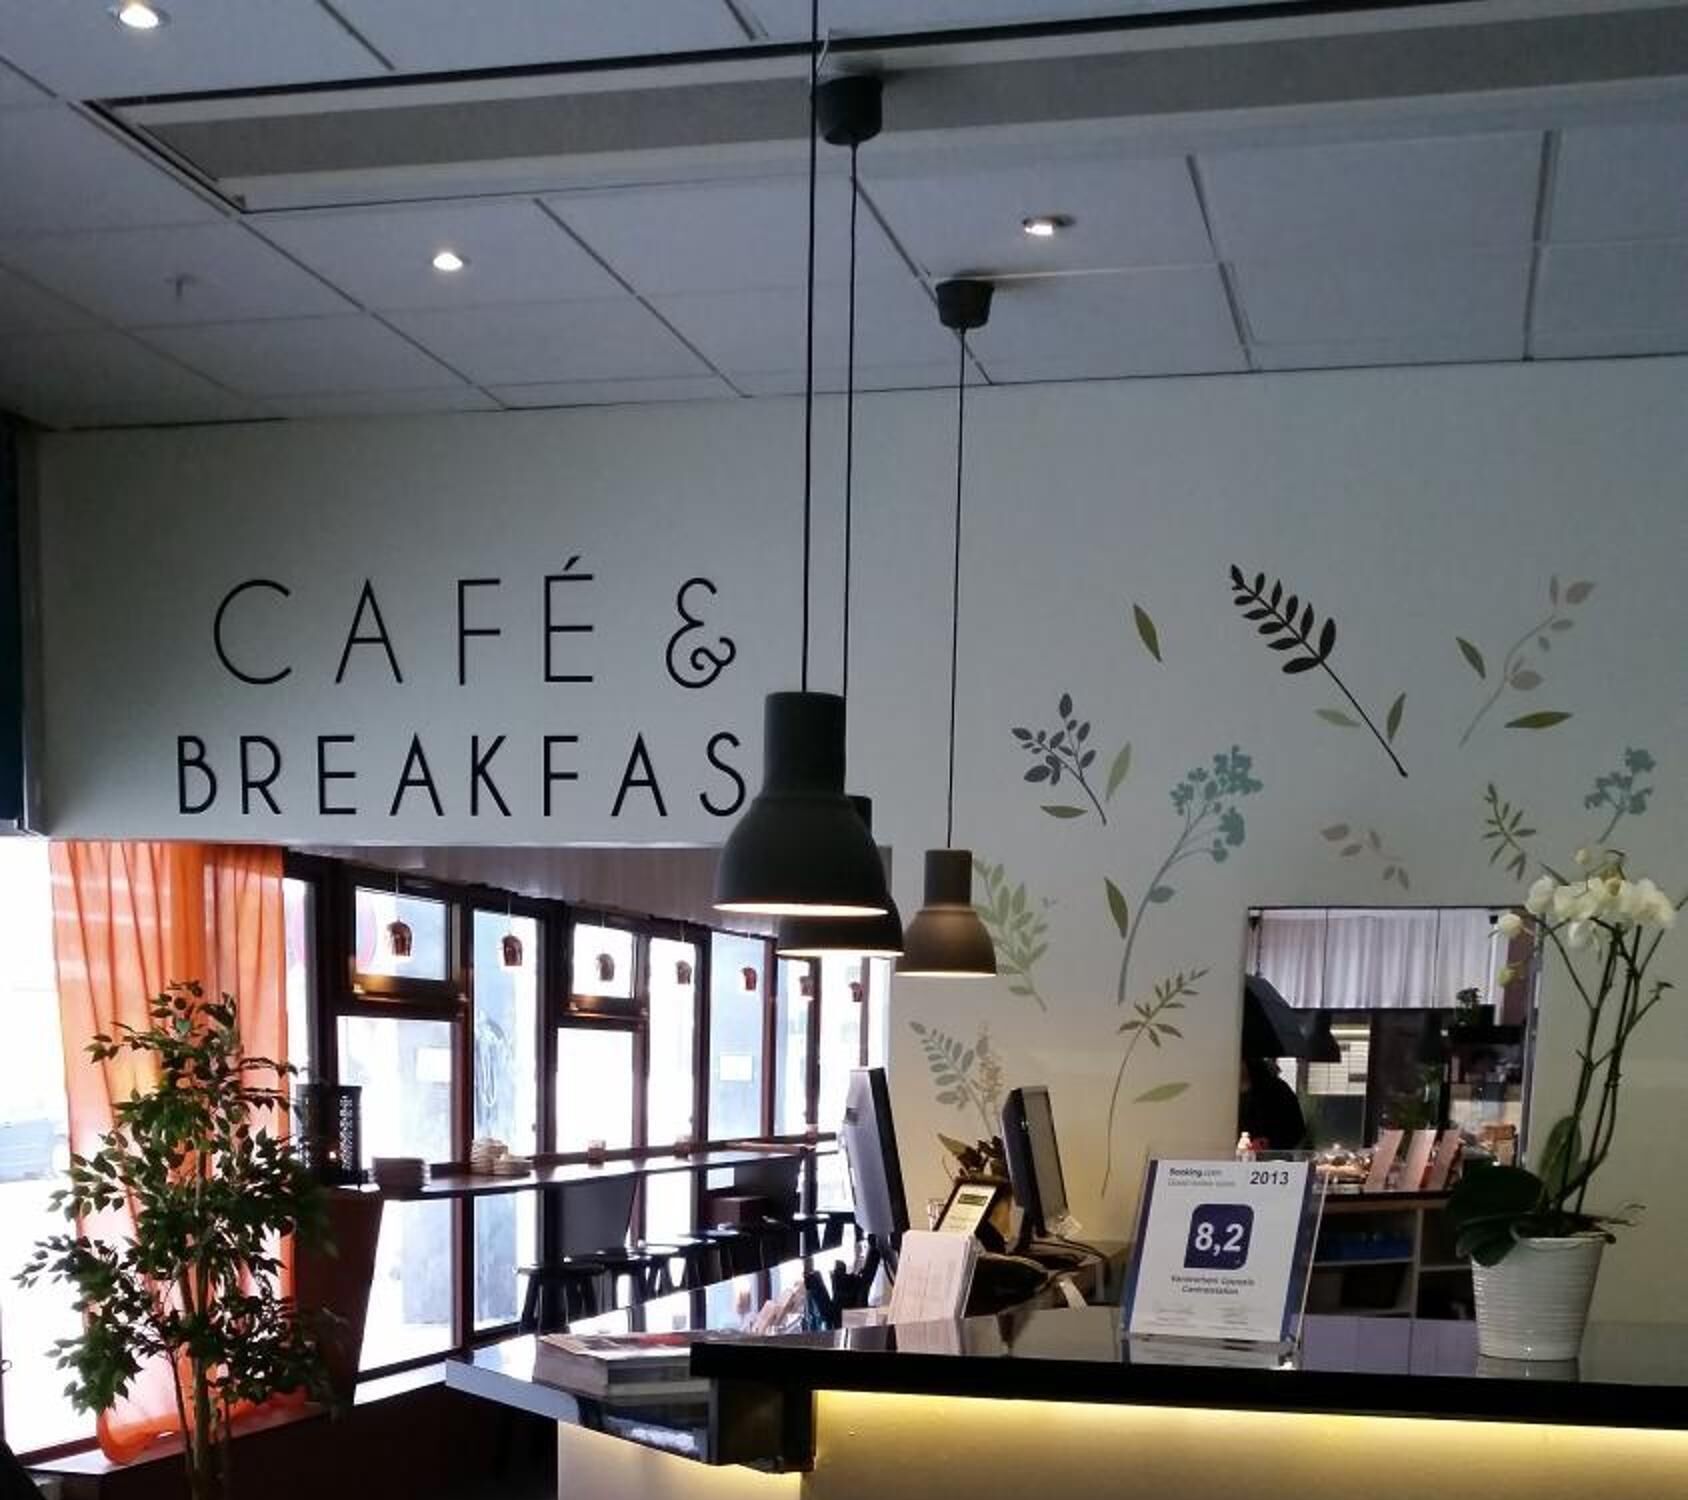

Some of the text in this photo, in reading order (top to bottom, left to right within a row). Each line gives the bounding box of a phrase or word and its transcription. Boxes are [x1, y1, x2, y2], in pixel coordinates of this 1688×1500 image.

[213, 555, 737, 689] CAFÉ &
[176, 731, 747, 817] BREAKFAS
[1250, 1171, 1289, 1185] 2013
[1195, 1222, 1244, 1256] 8,2
